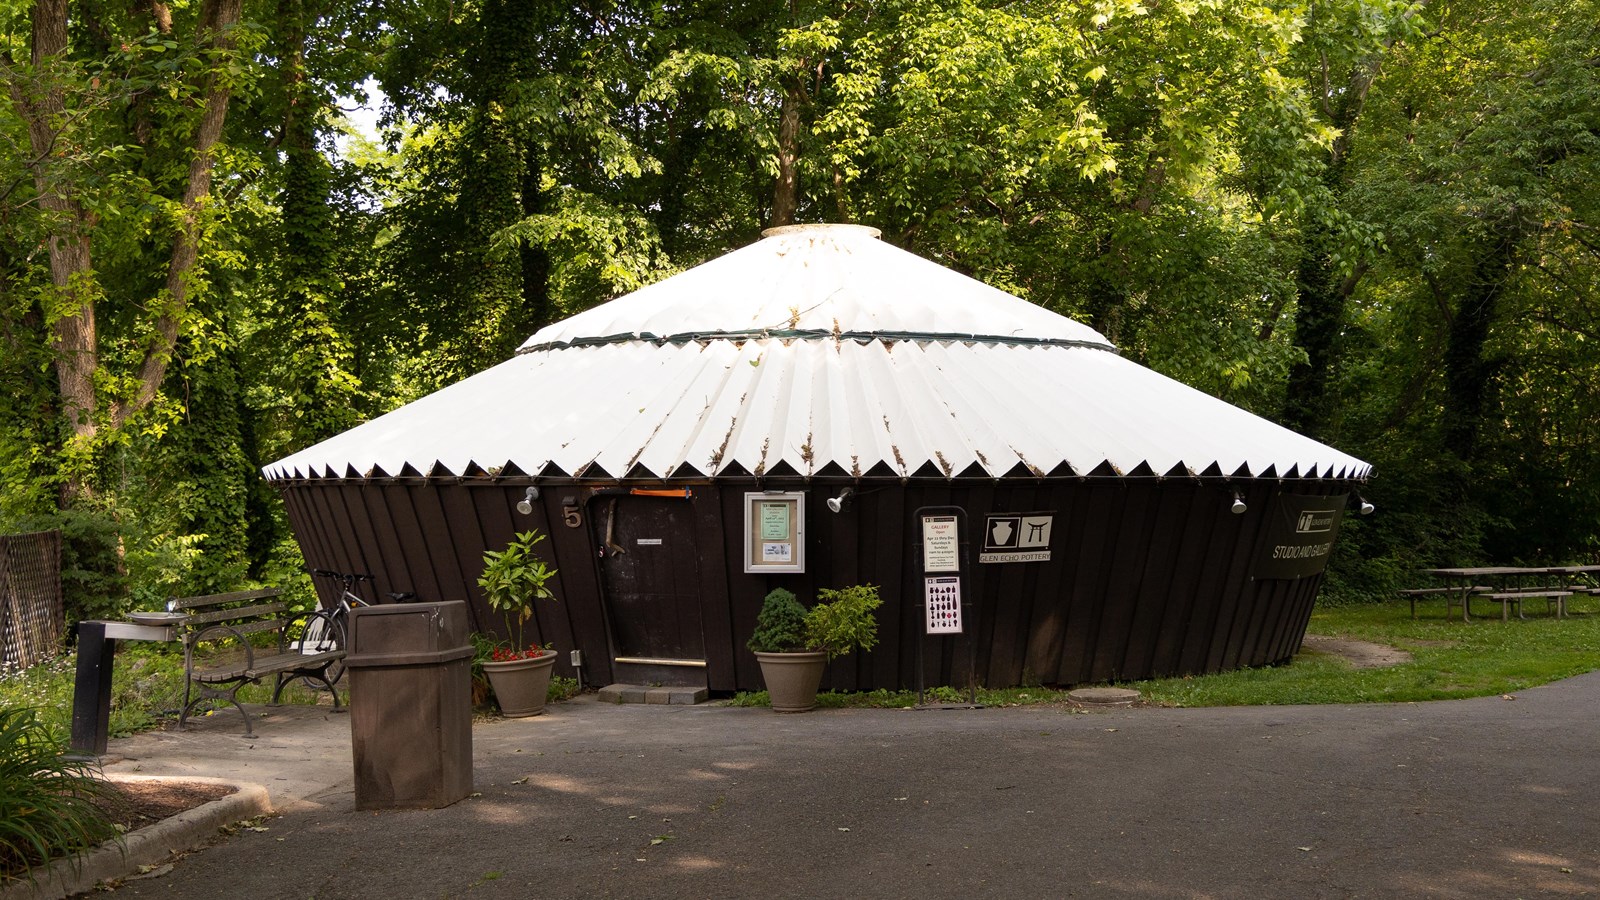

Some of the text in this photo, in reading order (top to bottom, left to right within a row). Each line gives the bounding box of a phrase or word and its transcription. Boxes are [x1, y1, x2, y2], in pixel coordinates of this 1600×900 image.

[563, 506, 582, 528] 5
[1272, 545, 1301, 559] STUDIO
[1298, 545, 1312, 558] AND
